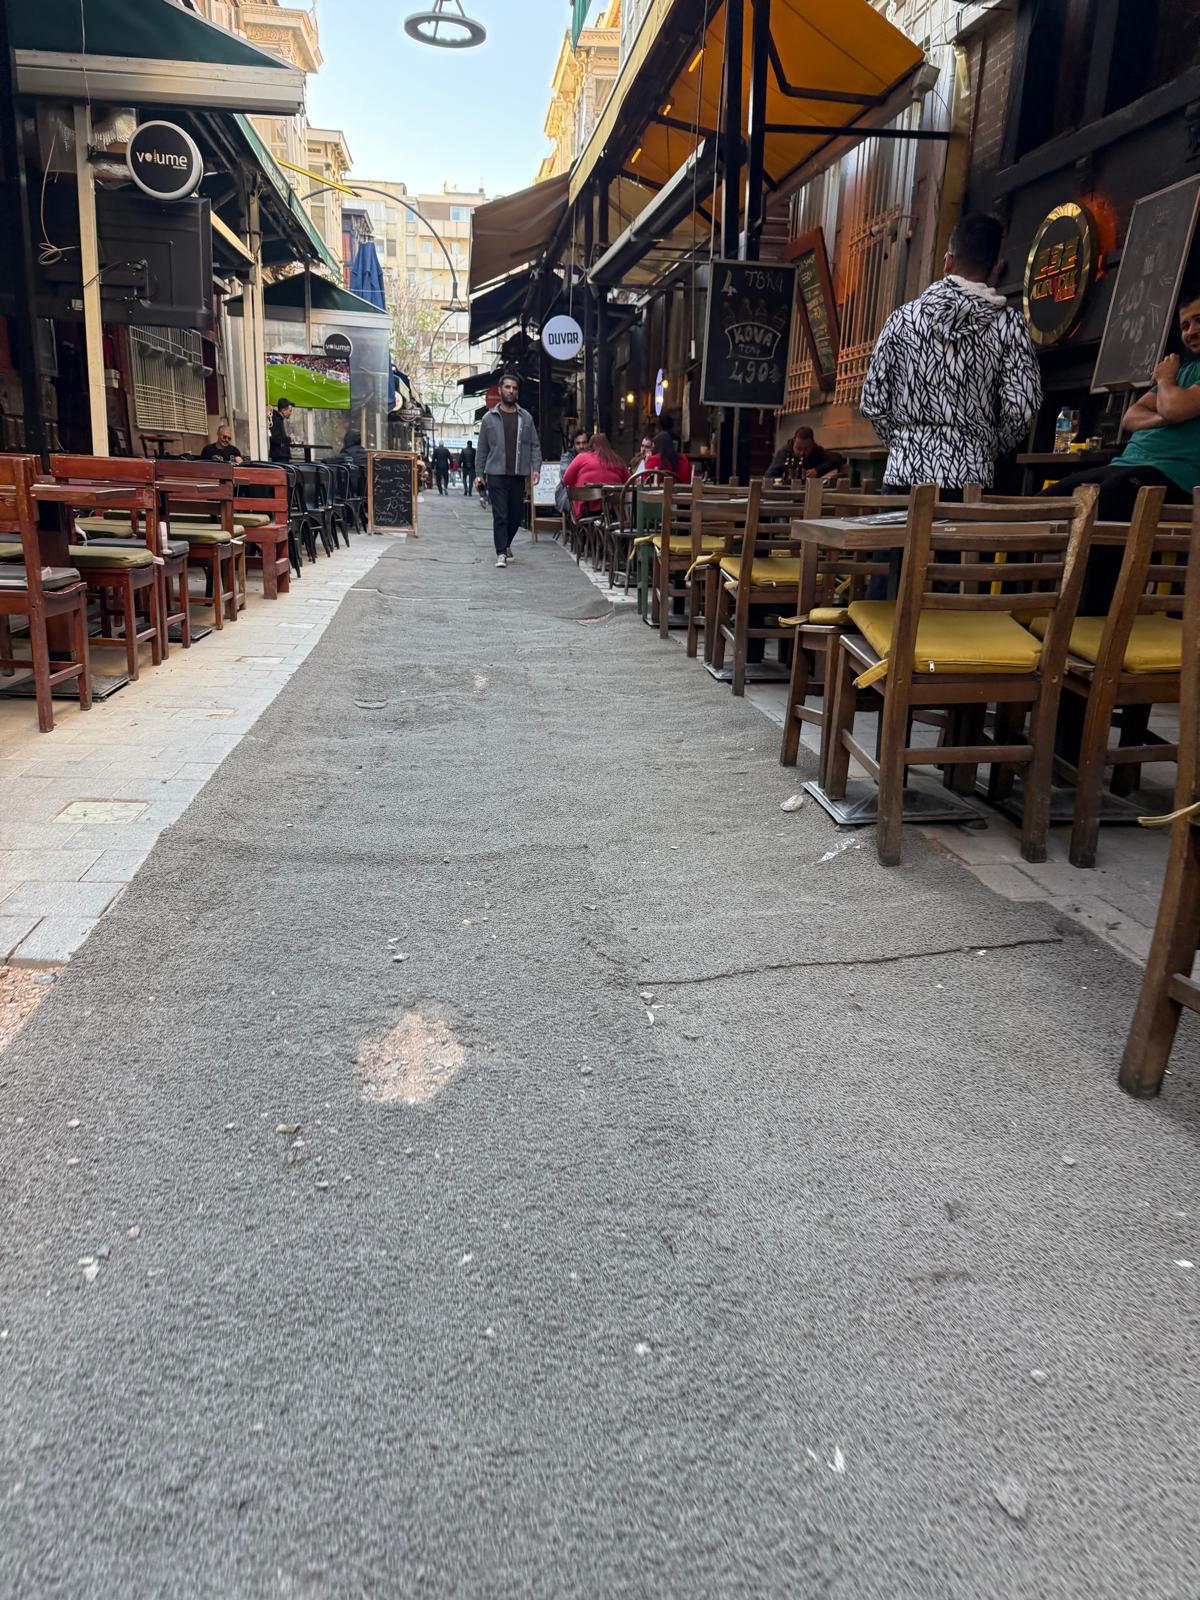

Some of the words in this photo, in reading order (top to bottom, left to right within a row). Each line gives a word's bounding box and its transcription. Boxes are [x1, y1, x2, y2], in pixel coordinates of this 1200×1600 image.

[136, 149, 187, 167] volume
[720, 269, 738, 297] 4
[548, 332, 579, 345] DUVAR
[733, 325, 774, 347] KOVA
